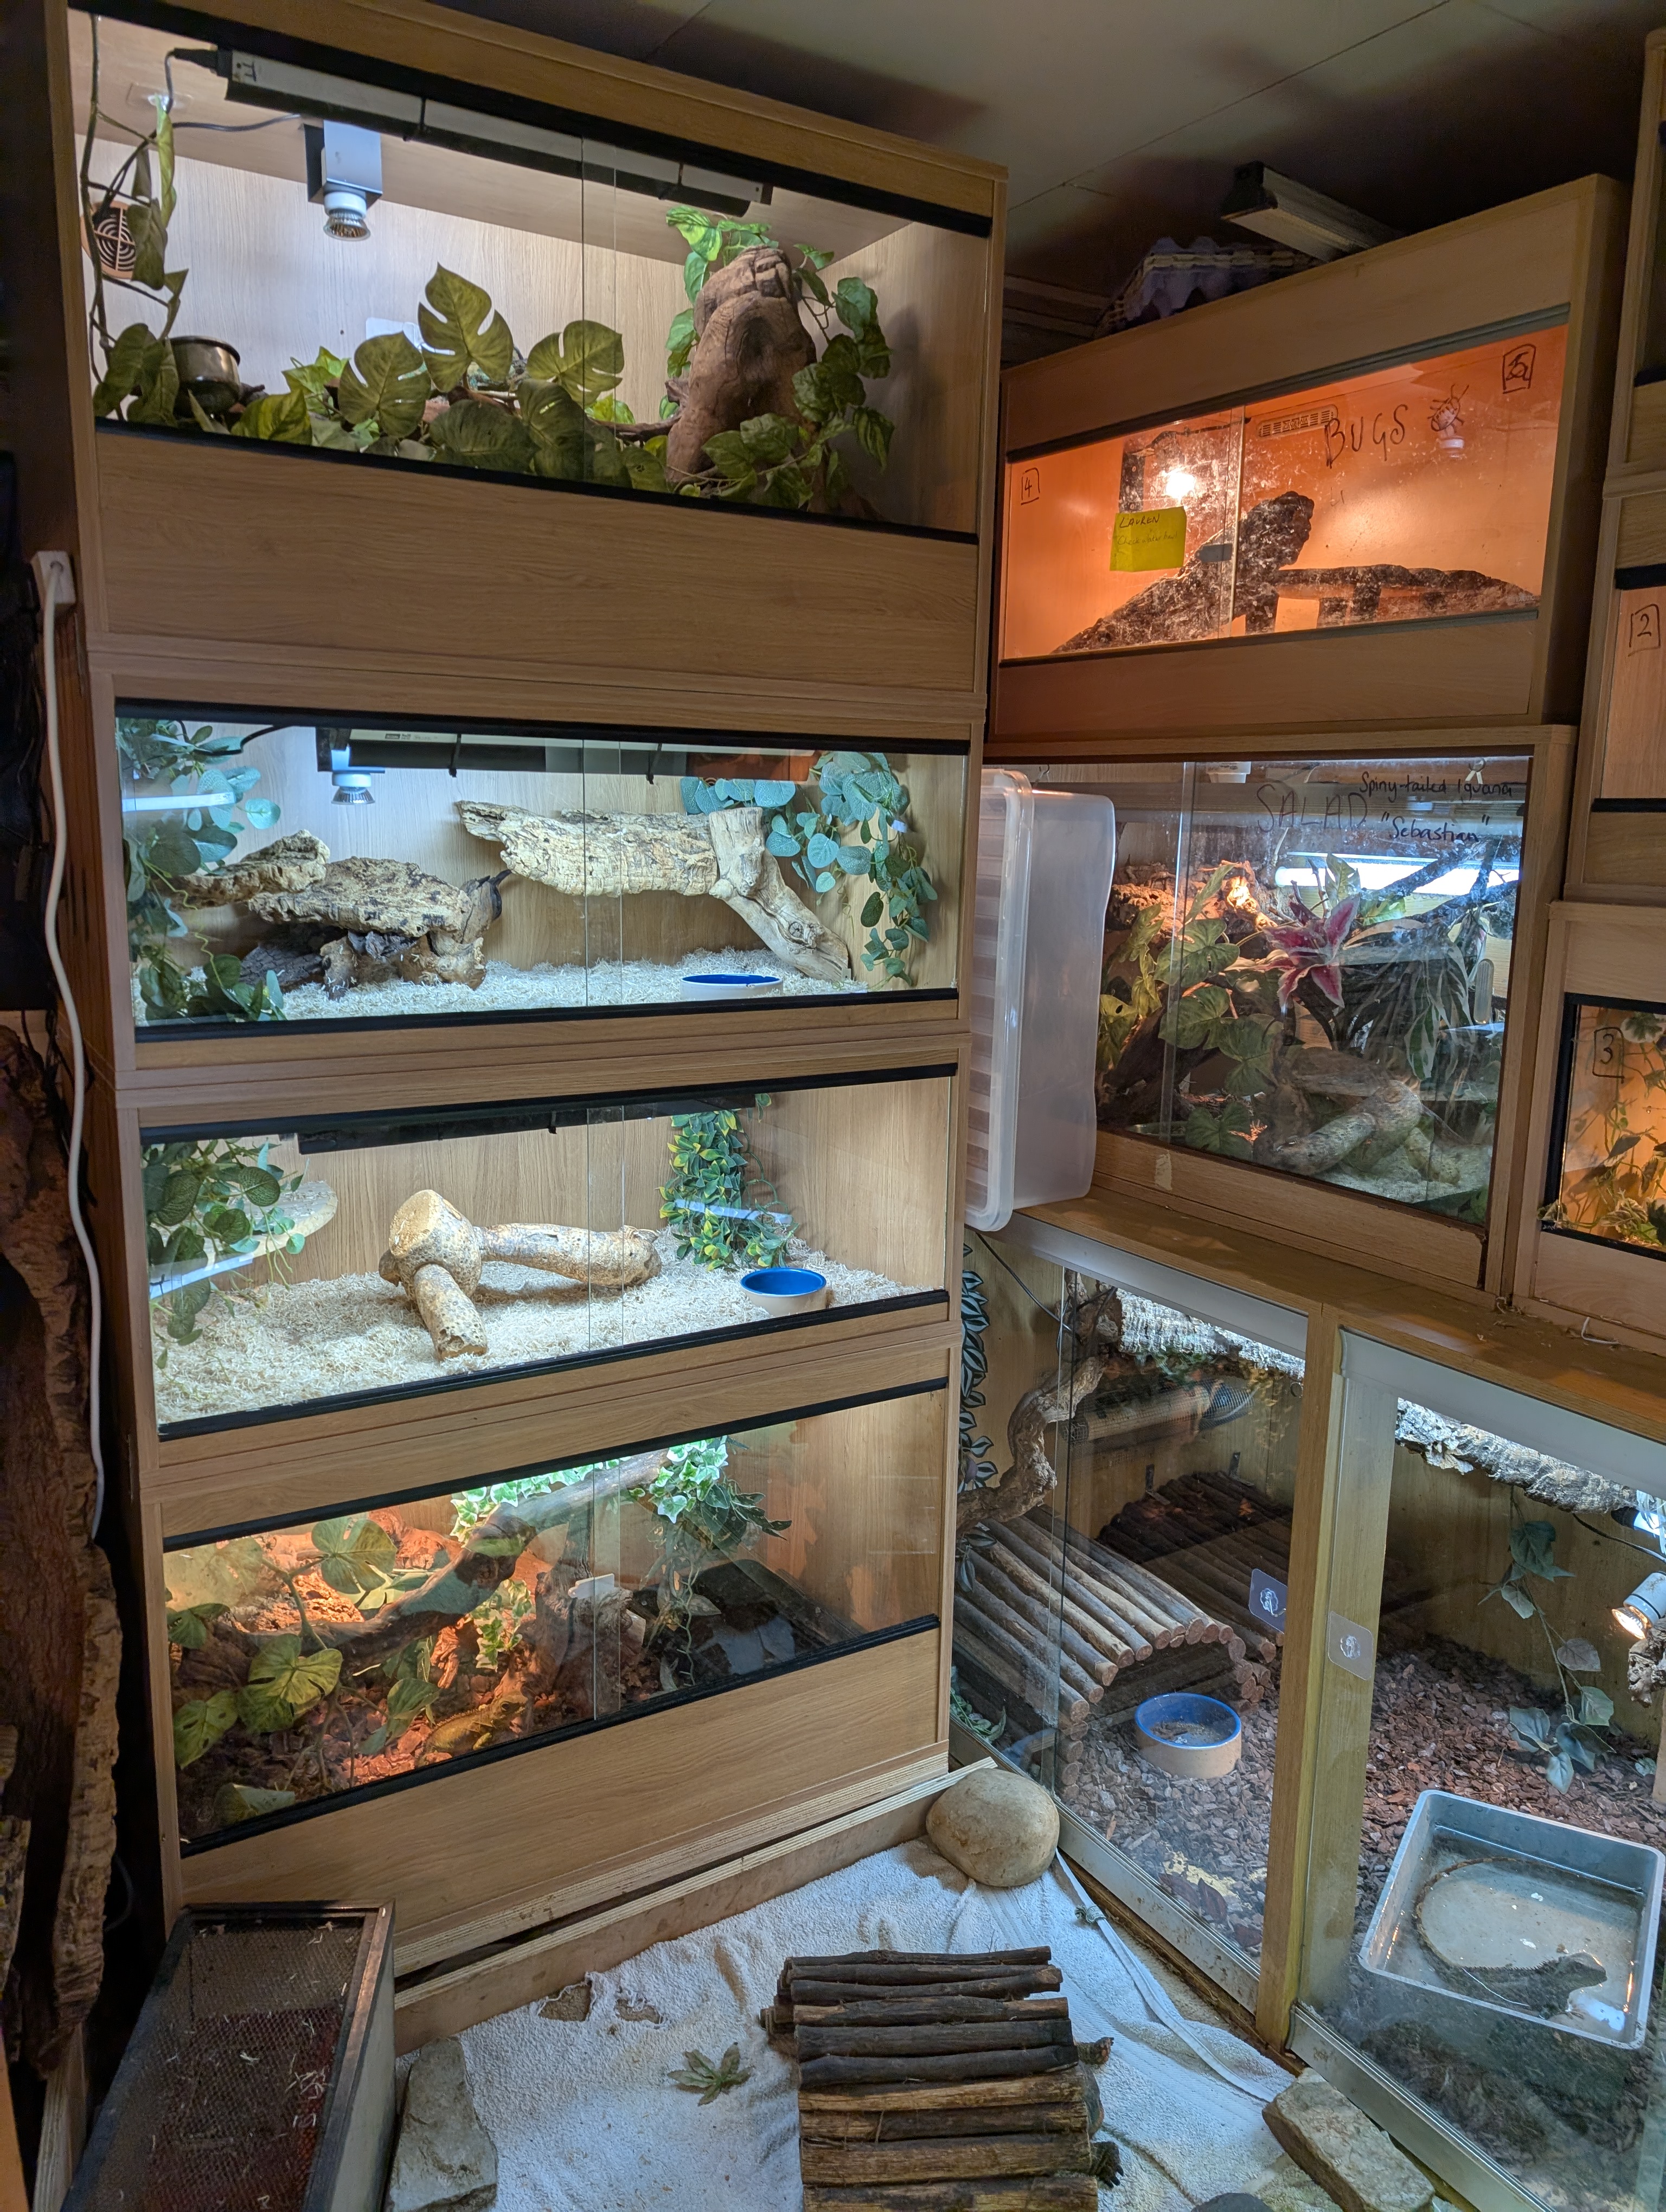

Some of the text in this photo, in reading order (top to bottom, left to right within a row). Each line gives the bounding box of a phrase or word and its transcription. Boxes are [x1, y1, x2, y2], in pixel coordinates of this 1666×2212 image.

[1324, 404, 1408, 469] BUGS
[1024, 477, 1032, 498] 4
[1119, 513, 1160, 528] LAUREN
[1637, 613, 1652, 636] 2
[1257, 783, 1368, 833] SALAD
[1600, 1033, 1614, 1064] 3
